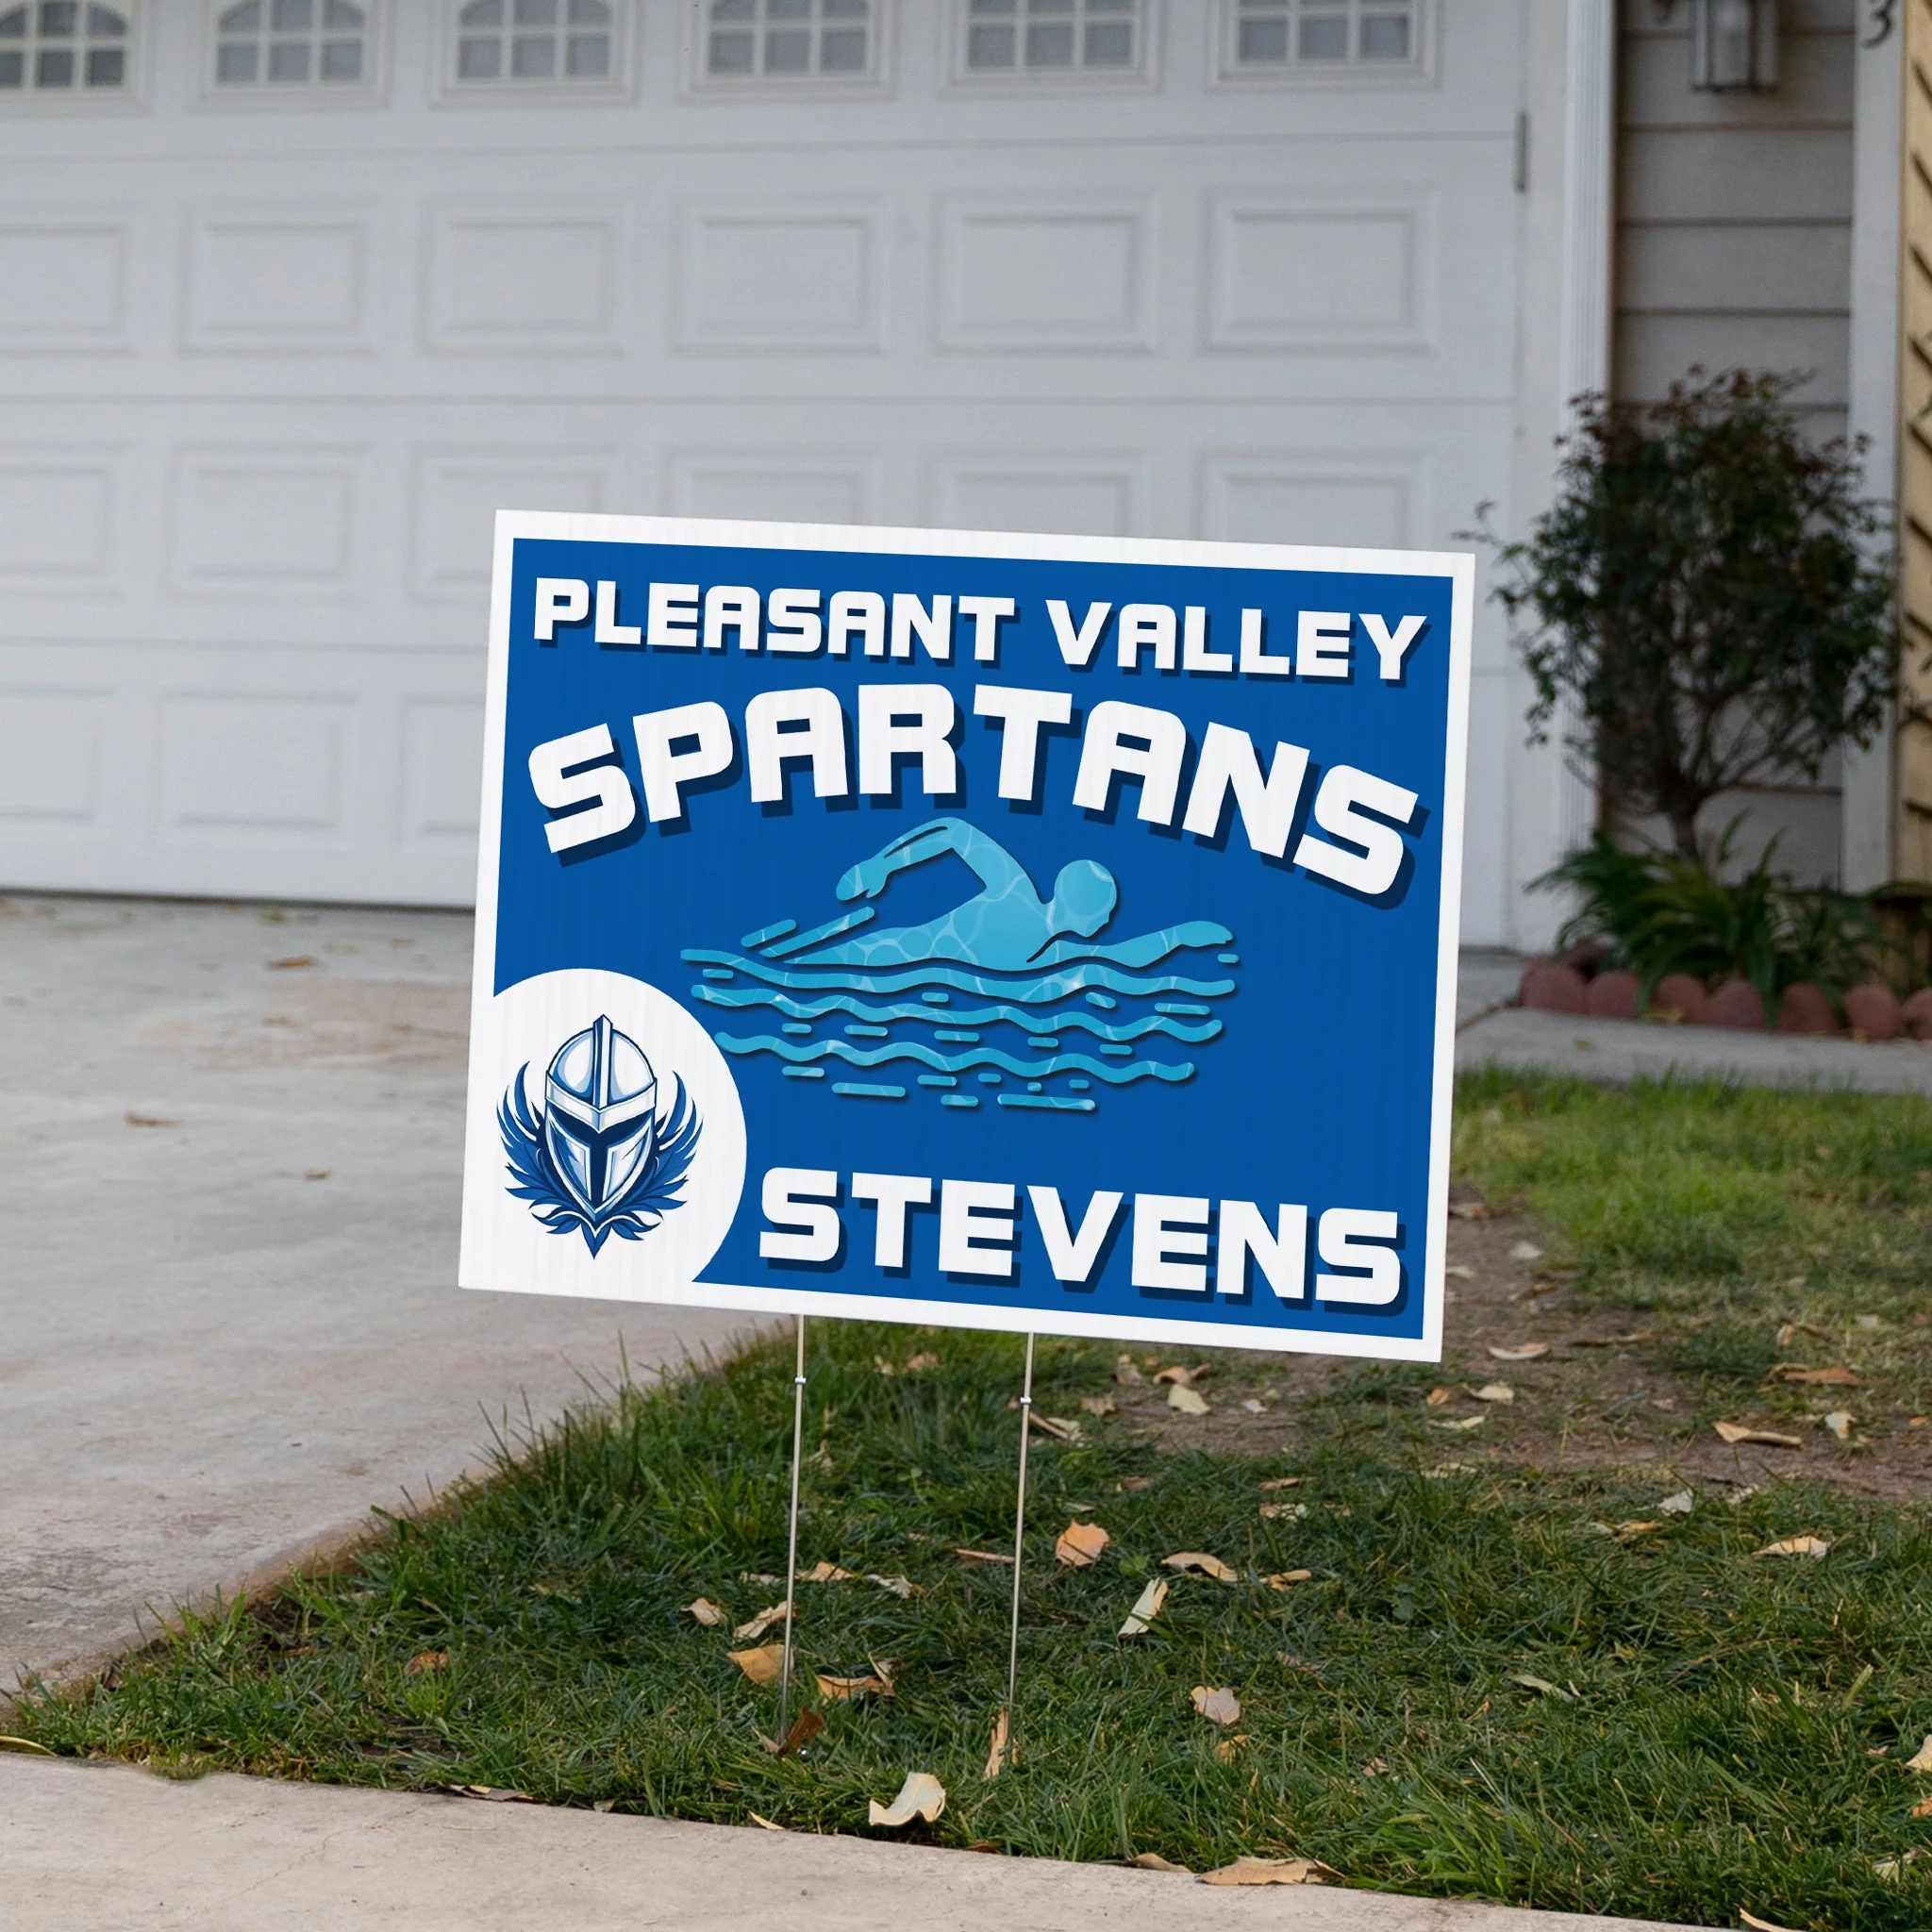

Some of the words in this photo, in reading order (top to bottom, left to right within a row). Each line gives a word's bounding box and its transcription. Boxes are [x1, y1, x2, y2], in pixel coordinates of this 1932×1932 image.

[534, 577, 1016, 662] PLEASANT
[1045, 599, 1427, 681] VALLEY
[528, 683, 1420, 895] SPARTANS
[759, 1167, 1402, 1306] STEVENS
